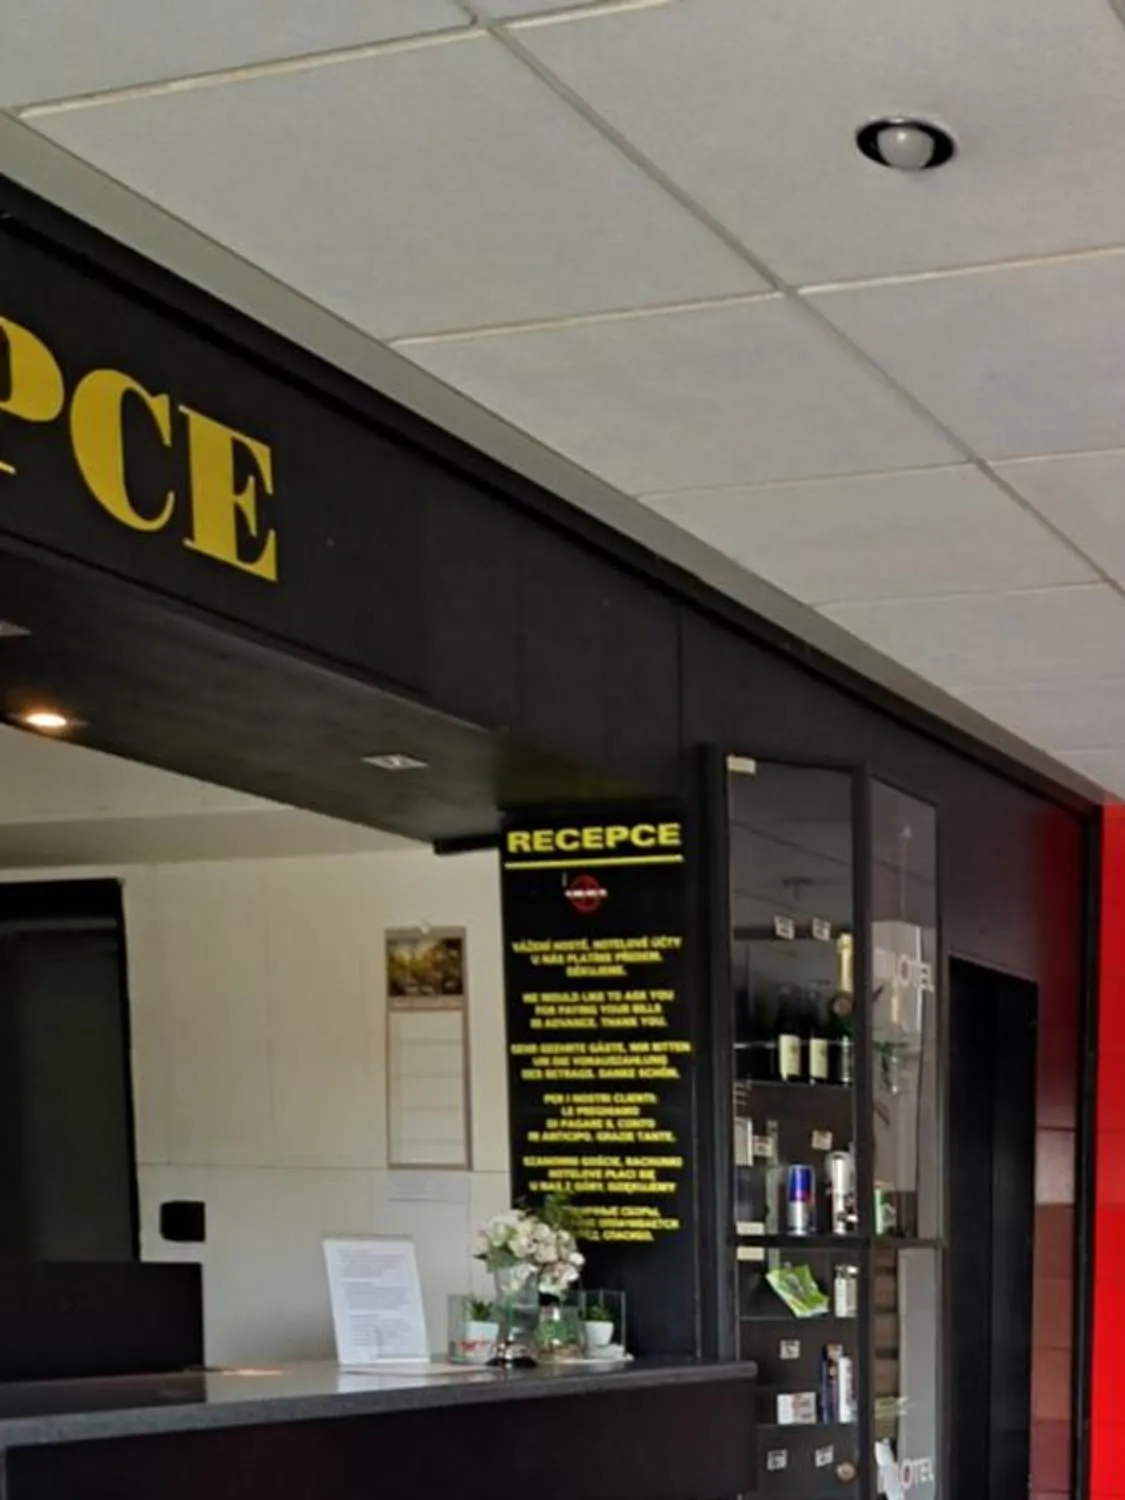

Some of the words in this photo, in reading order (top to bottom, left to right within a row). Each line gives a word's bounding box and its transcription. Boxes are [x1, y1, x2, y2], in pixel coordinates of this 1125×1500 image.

[507, 822, 683, 853] RECEPCE
[541, 992, 579, 1003] WOULD
[582, 991, 605, 1002] LIKE
[607, 991, 622, 1002] TO
[625, 990, 646, 1001] ASK
[650, 990, 674, 1001] YOU
[534, 1005, 555, 1015] FOR
[601, 1004, 629, 1014] YOUR
[632, 1003, 661, 1014] BILLS
[601, 1017, 637, 1028] THANK
